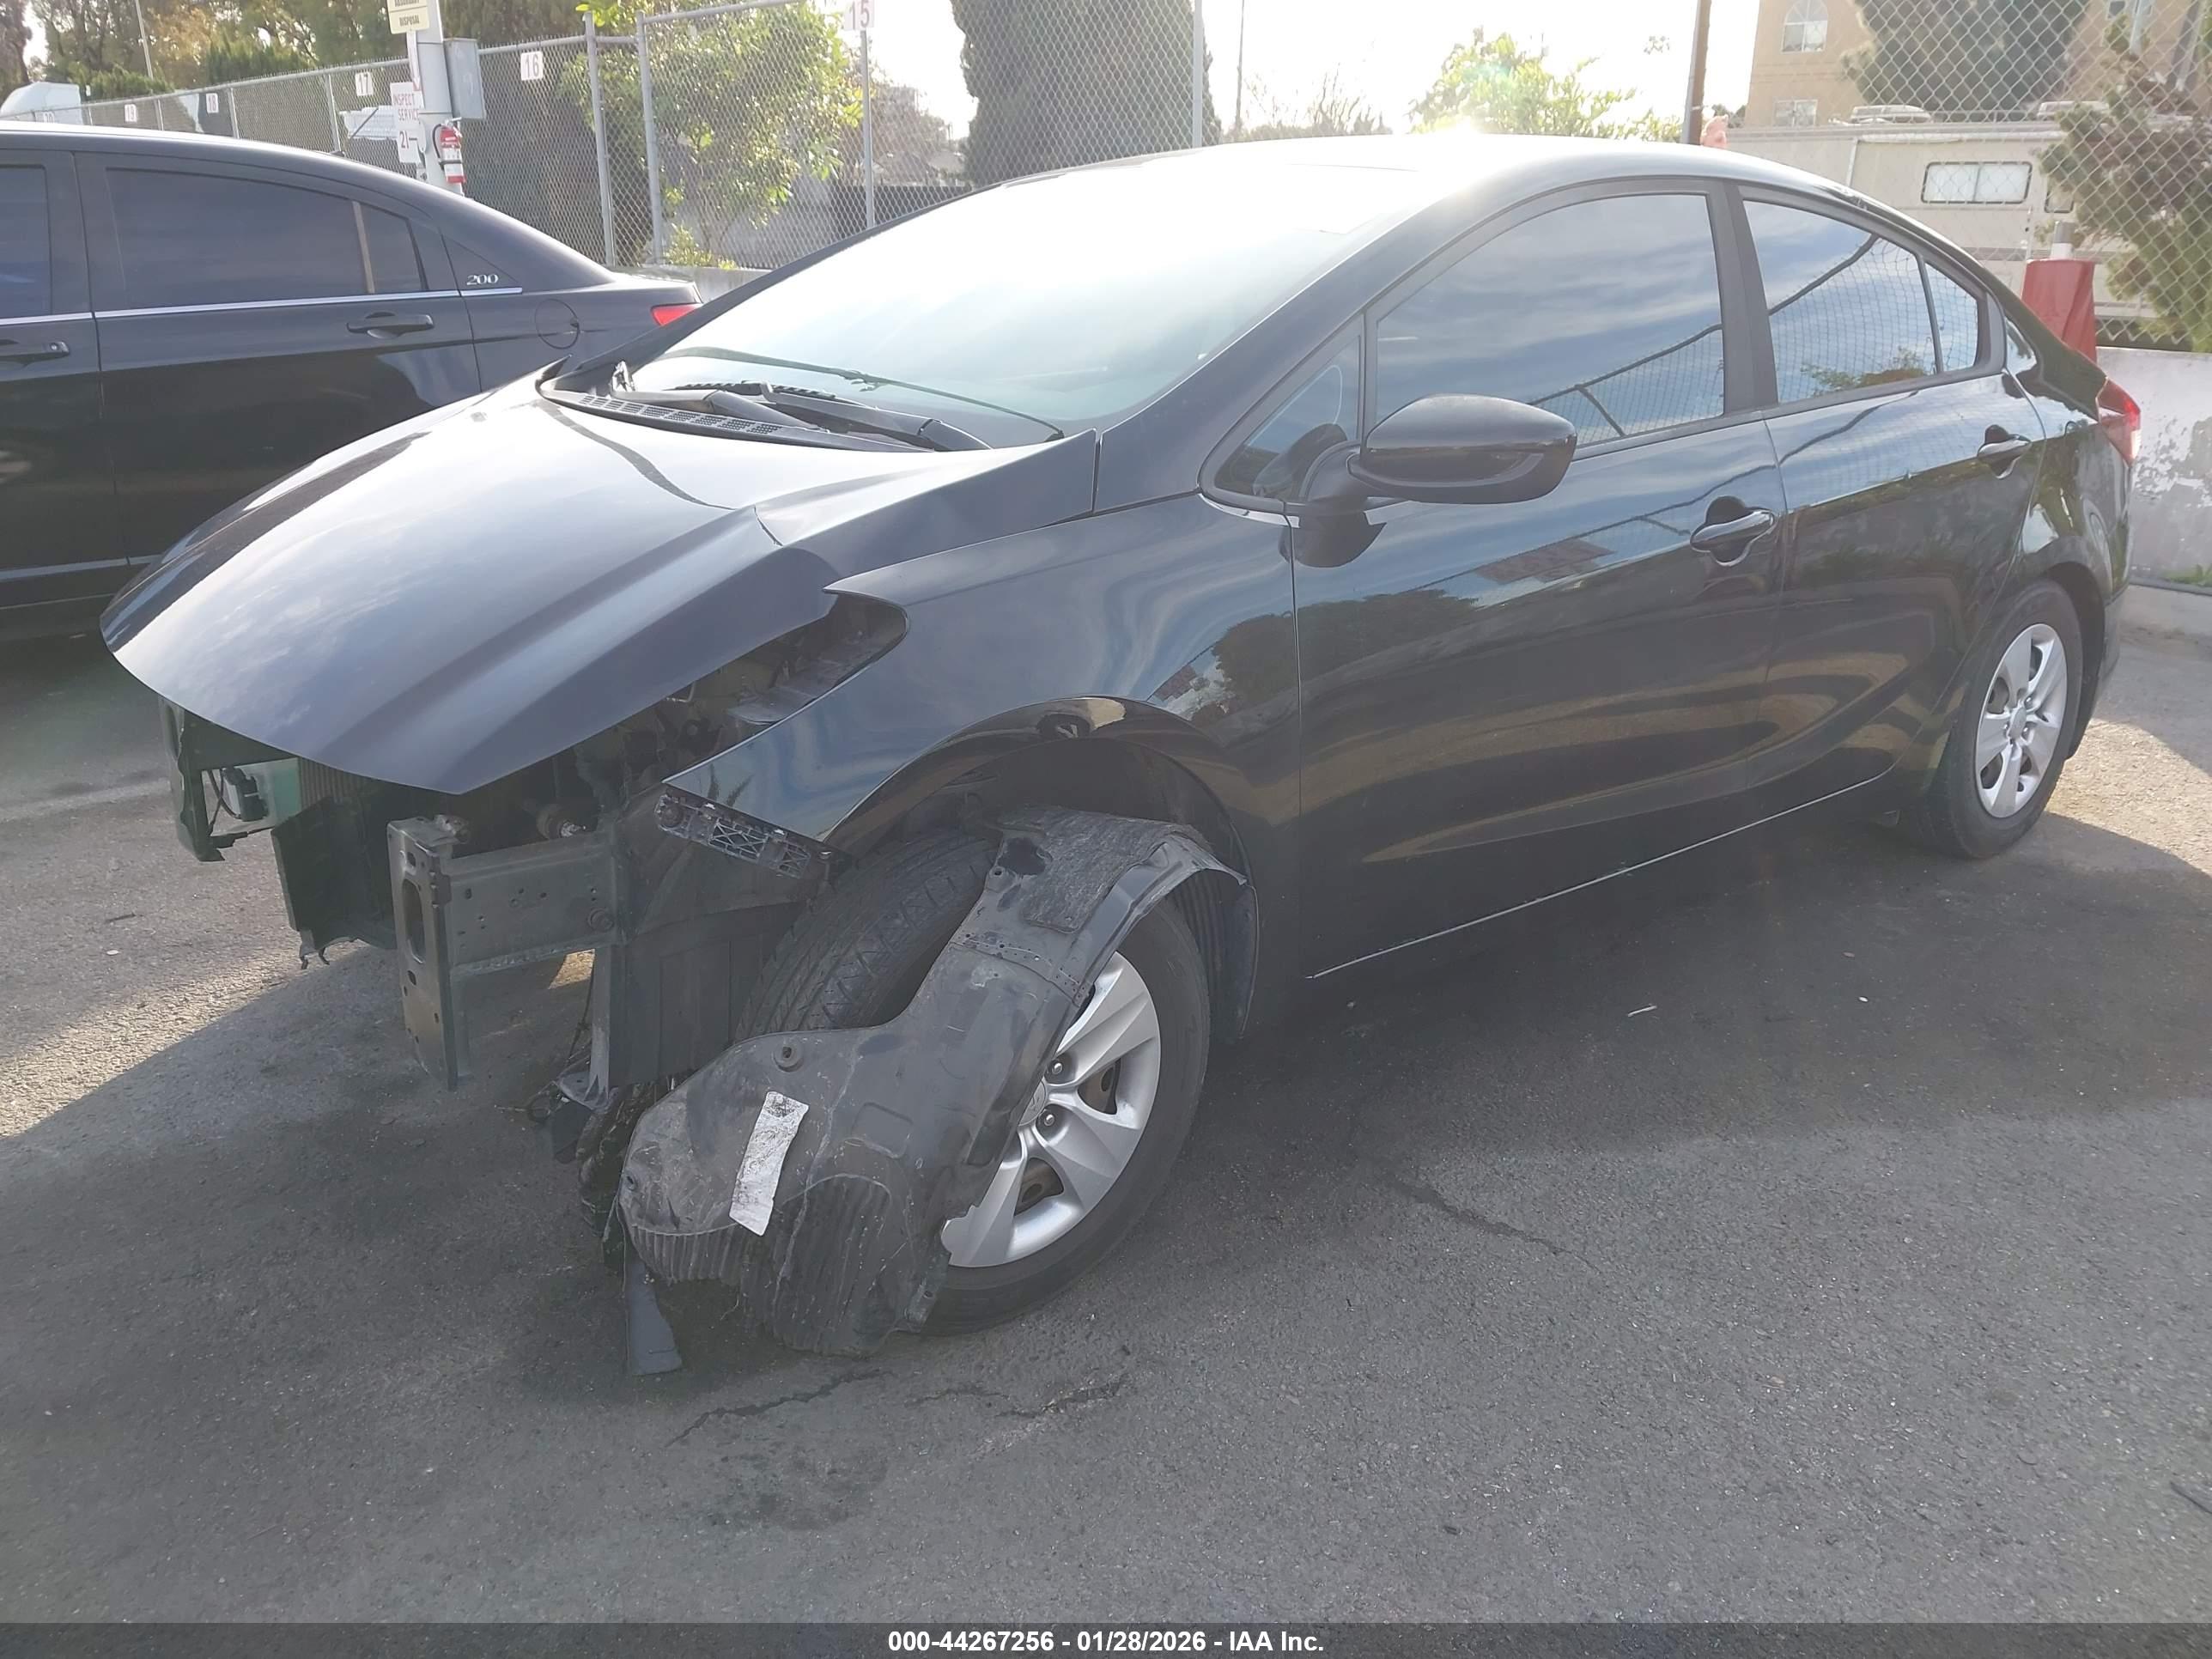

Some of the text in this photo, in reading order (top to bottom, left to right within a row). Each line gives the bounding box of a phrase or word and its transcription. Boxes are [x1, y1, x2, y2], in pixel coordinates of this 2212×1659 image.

[851, 0, 870, 30] 15
[525, 53, 540, 78] 16
[358, 73, 368, 94] 17
[208, 95, 216, 111] 18
[466, 274, 499, 286] 200
